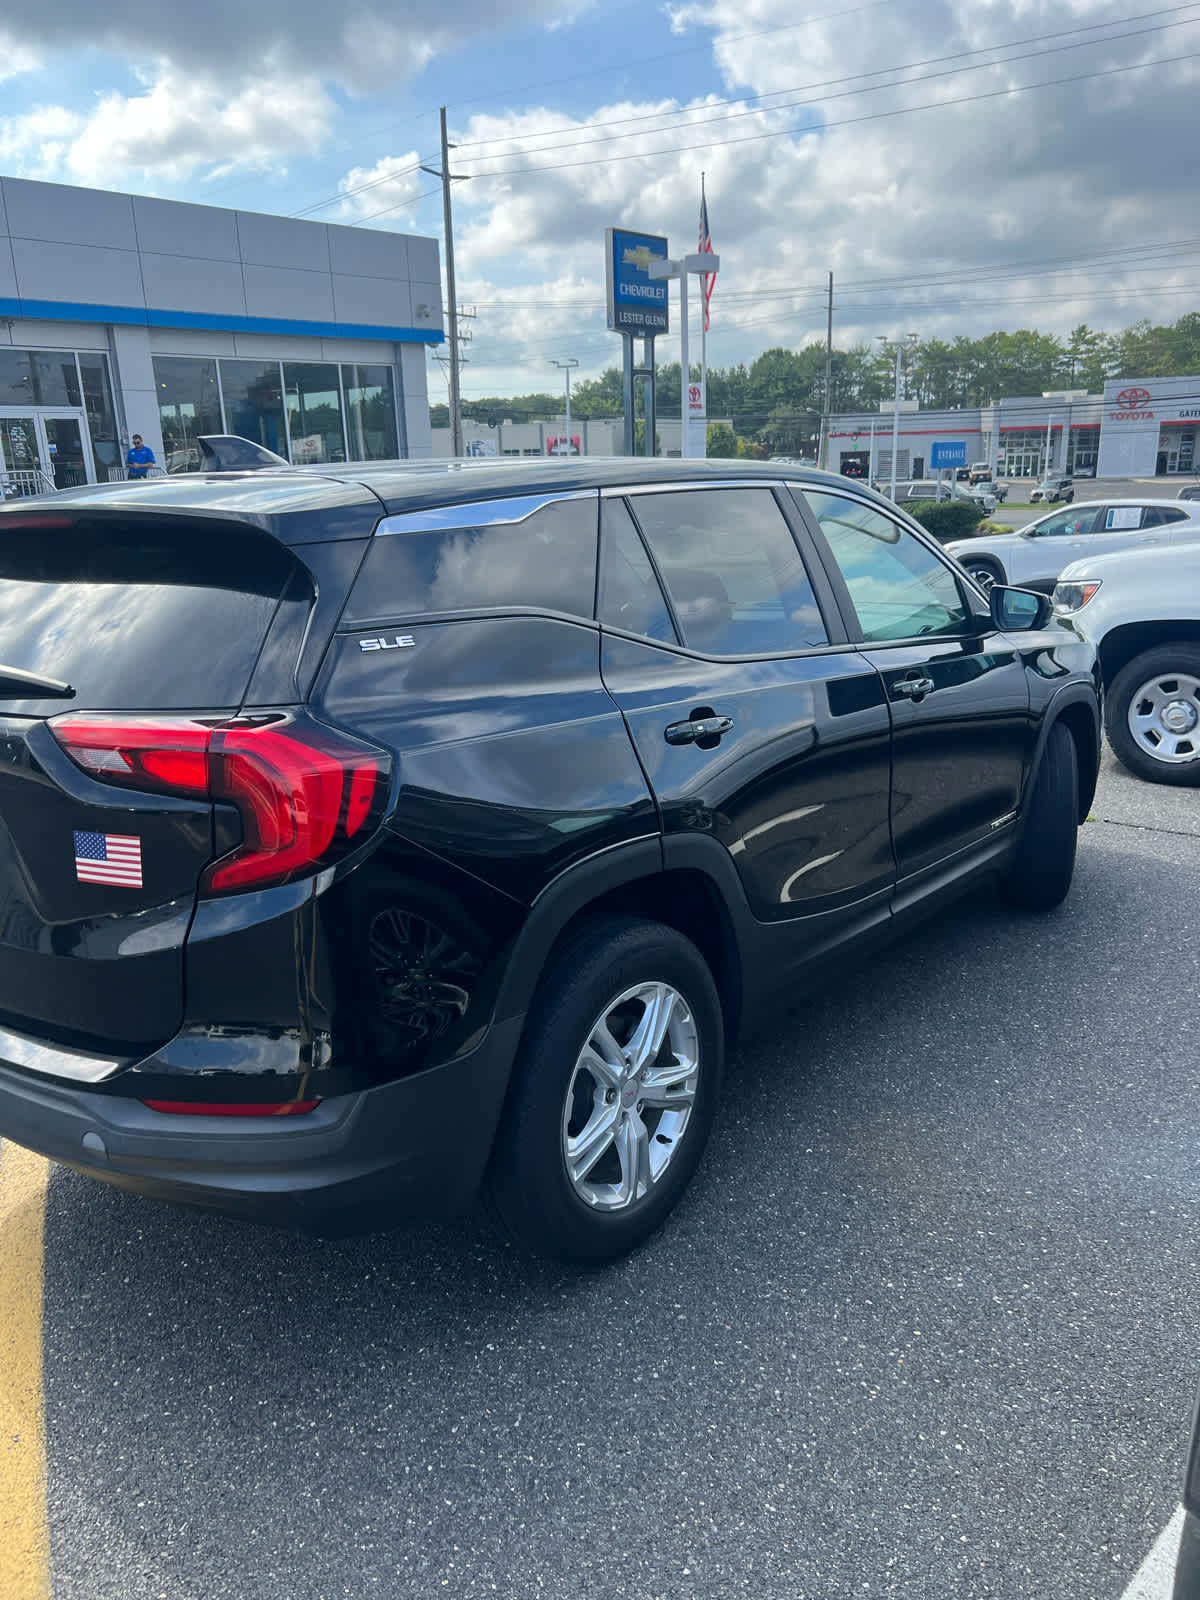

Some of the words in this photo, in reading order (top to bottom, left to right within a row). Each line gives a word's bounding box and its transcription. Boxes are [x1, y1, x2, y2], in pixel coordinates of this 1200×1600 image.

[619, 283, 665, 299] CHEVROLET
[619, 311, 644, 325] LESTER
[645, 314, 666, 328] GLENN
[1109, 411, 1154, 420] TOYOTA
[359, 635, 416, 652] SLE
